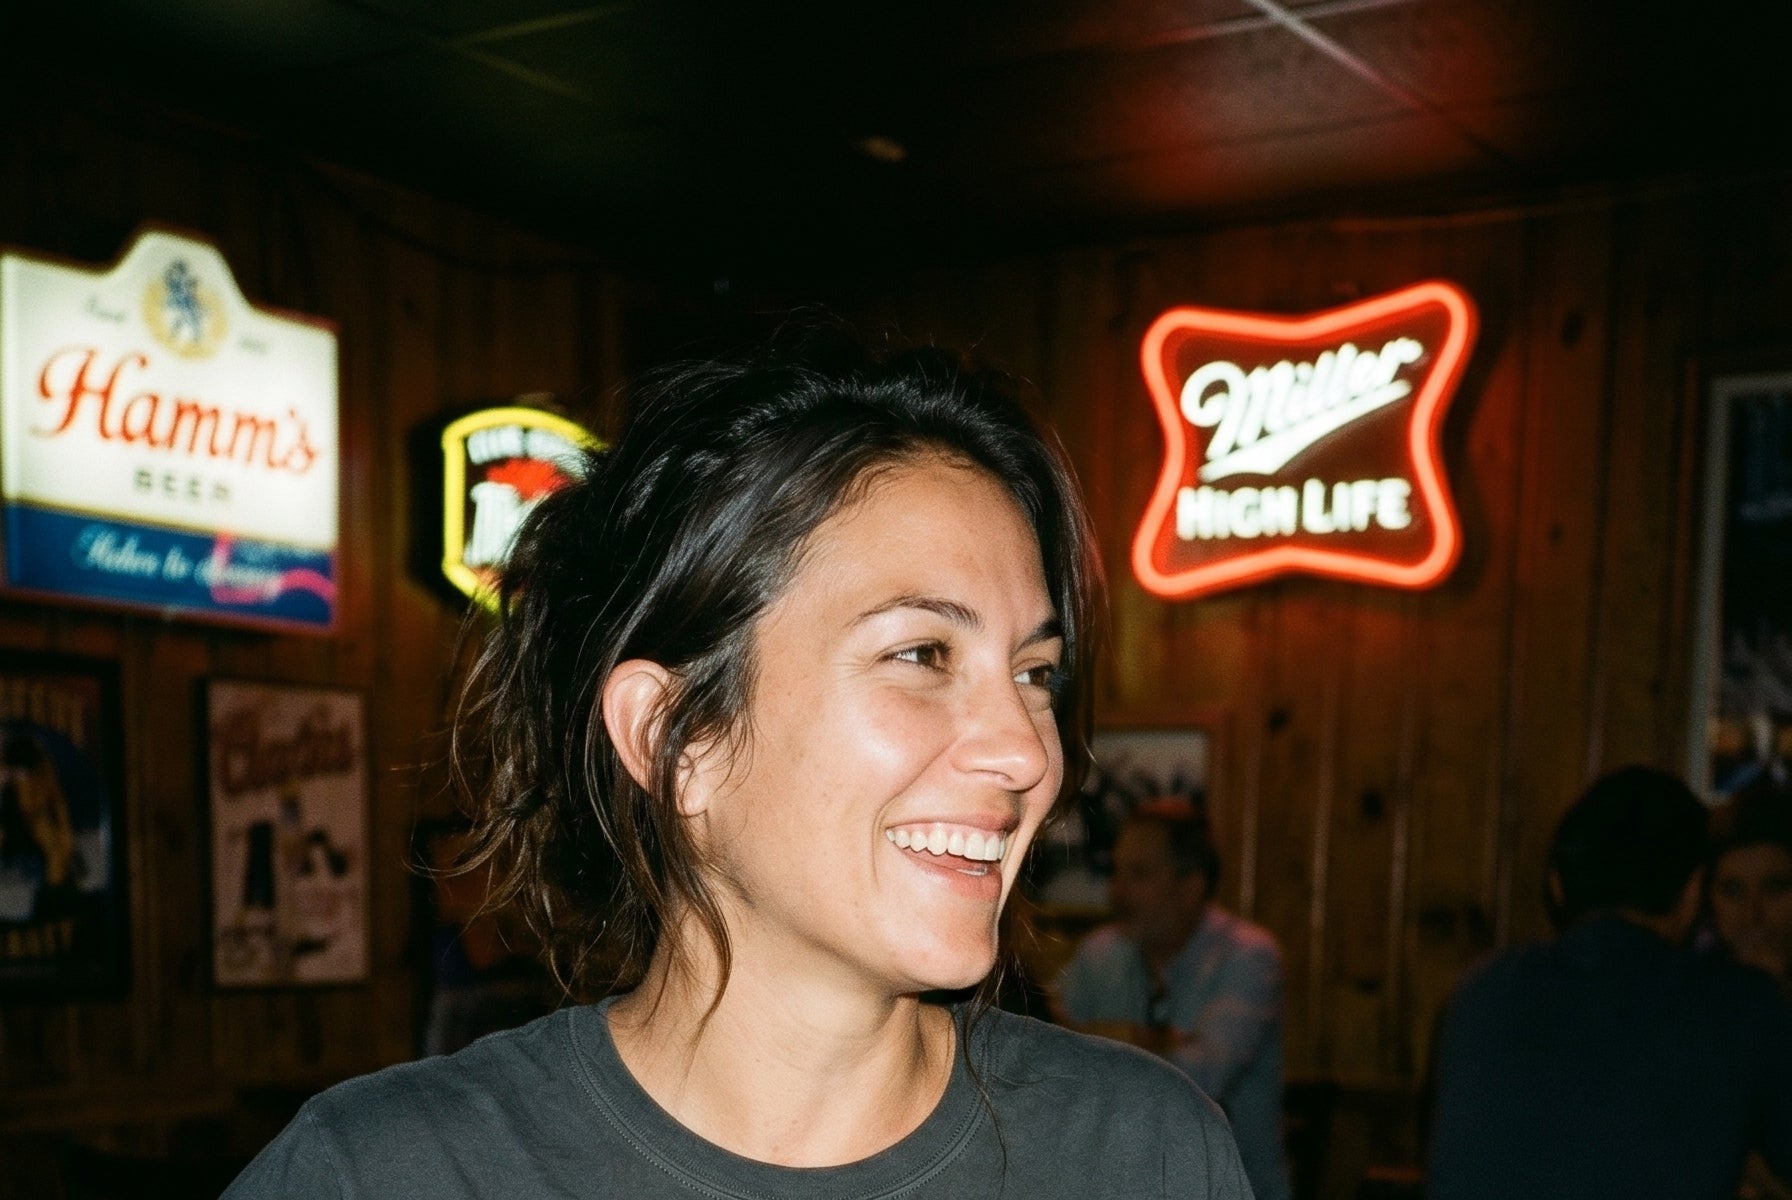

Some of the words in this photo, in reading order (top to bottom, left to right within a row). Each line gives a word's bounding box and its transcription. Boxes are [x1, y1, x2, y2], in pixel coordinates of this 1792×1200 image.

[29, 344, 320, 474] Hamm's
[1180, 337, 1424, 461] Miller
[1177, 485, 1298, 540] HIGH
[1302, 478, 1411, 534] LIFE
